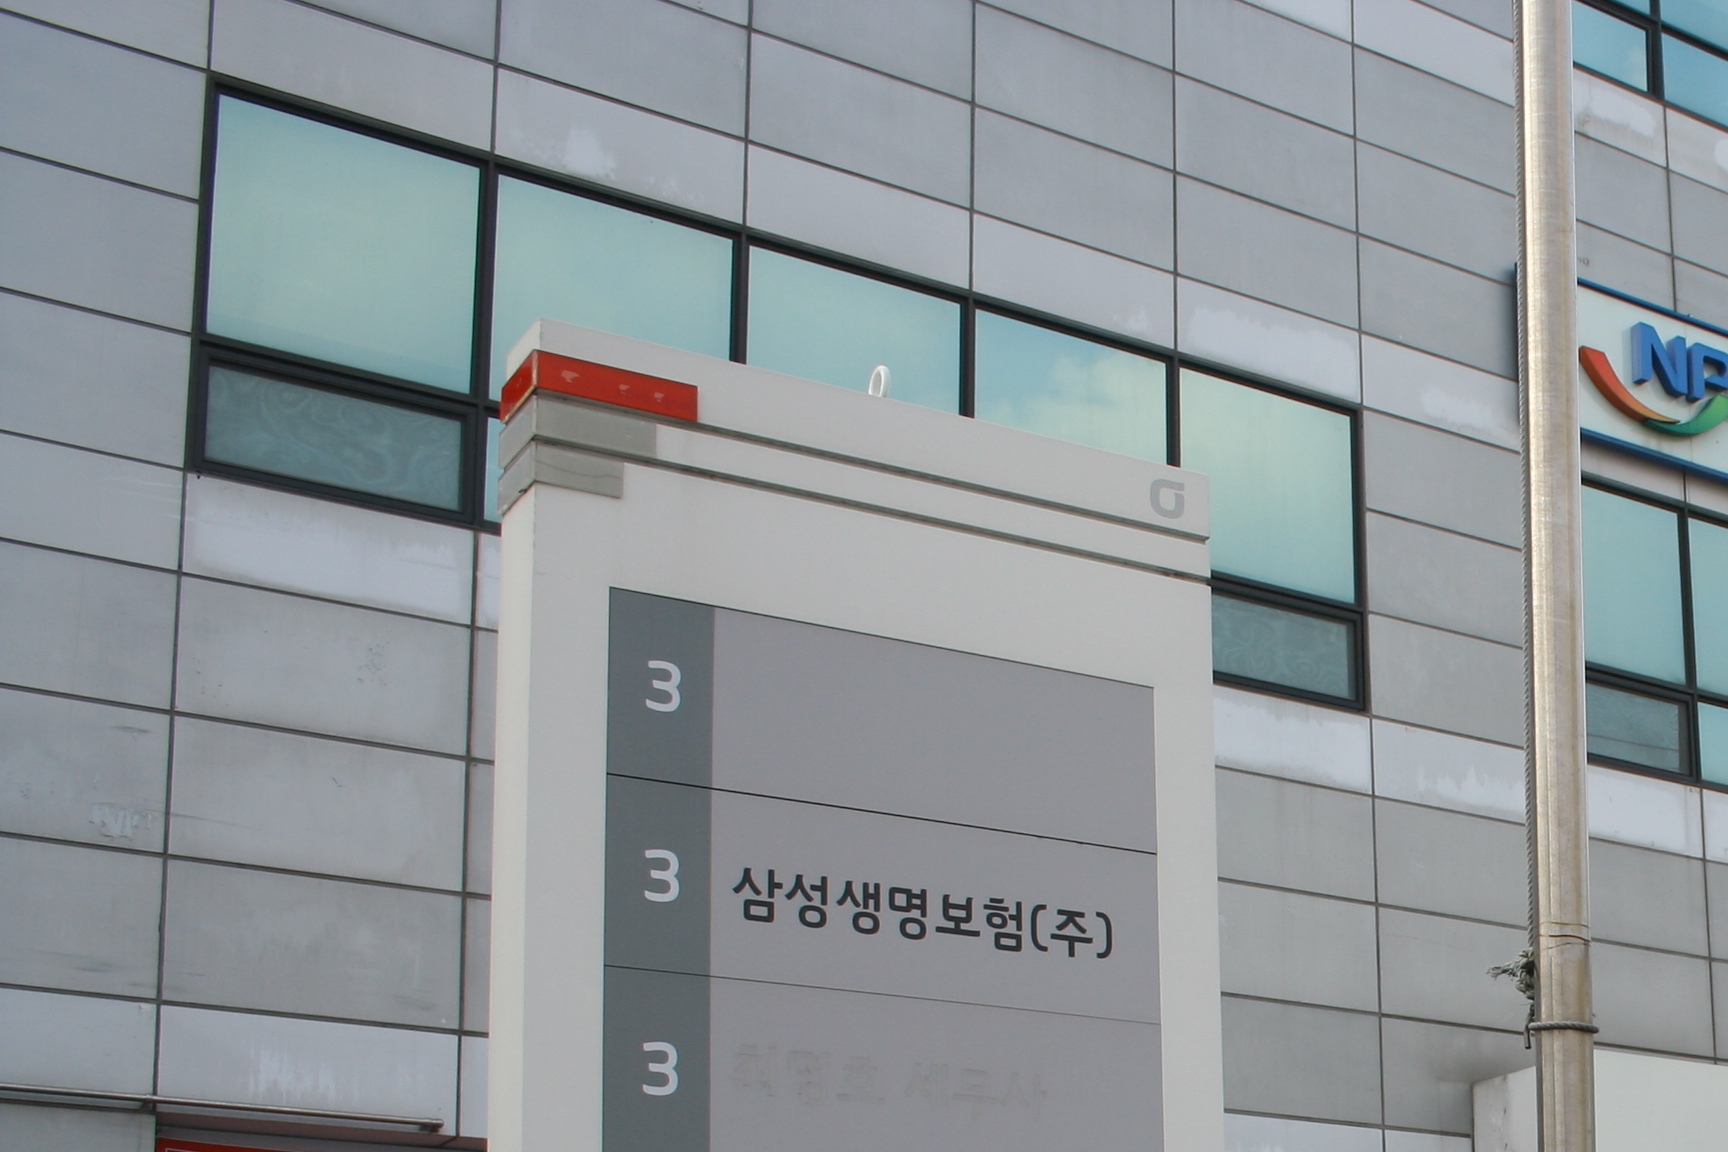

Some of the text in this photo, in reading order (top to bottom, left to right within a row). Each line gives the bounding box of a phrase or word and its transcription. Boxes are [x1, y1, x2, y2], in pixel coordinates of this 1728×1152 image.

[645, 660, 681, 712] 3
[644, 849, 1114, 960] 3 삼성생명보험(주)
[642, 1041, 679, 1096] 3
